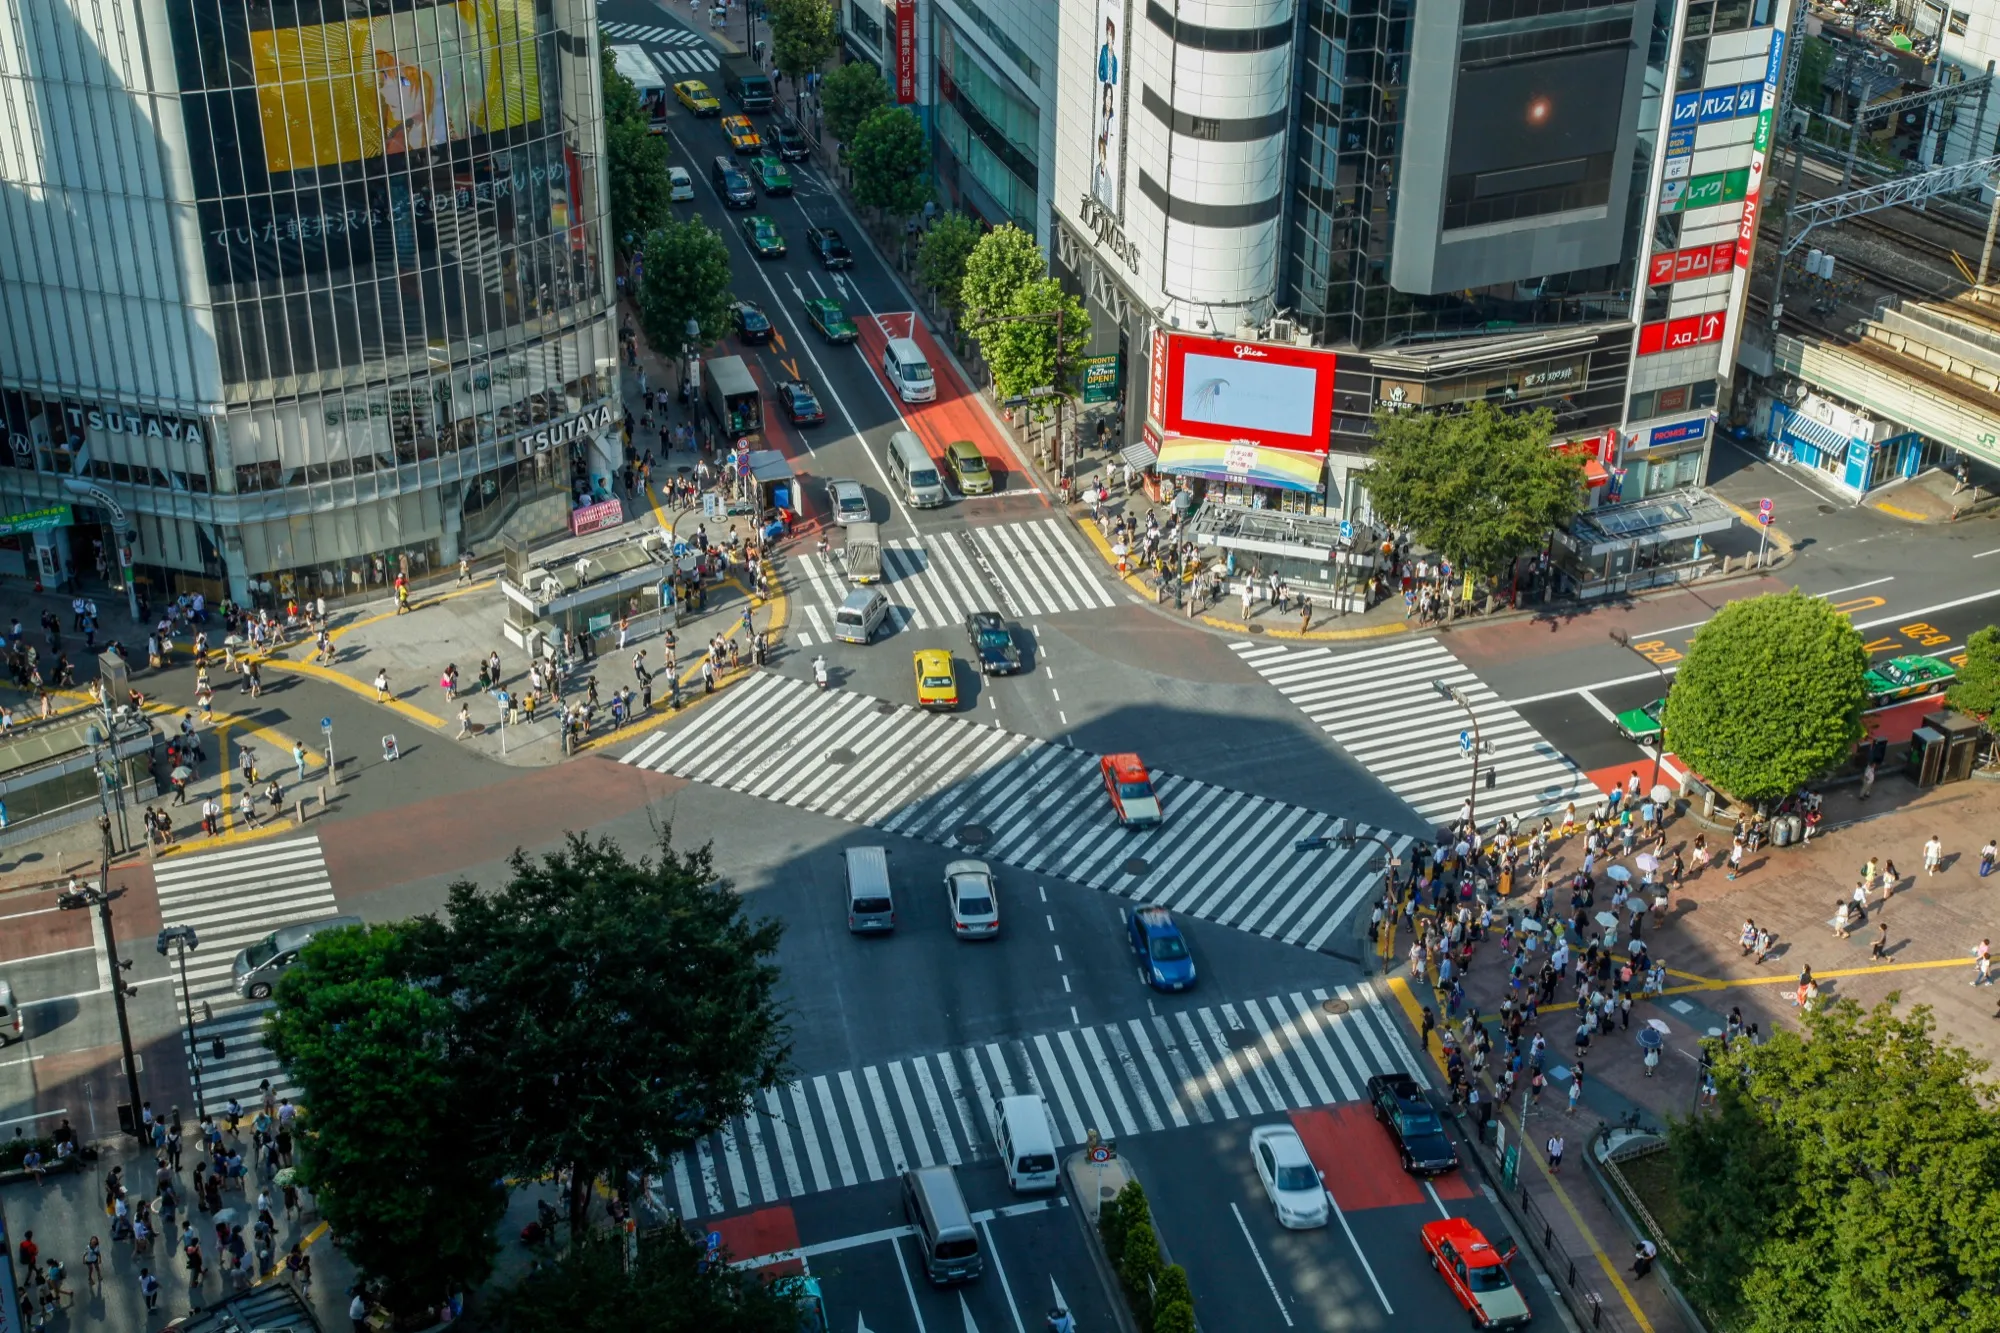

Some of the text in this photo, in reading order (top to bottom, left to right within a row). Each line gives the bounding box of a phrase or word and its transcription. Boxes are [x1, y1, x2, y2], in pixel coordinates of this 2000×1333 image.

[1758, 115, 1769, 143] レイク
[1671, 167, 1681, 176] 6F
[1687, 181, 1722, 200] レイク
[1742, 201, 1755, 240] アコム
[1655, 254, 1708, 277] アコム
[1672, 332, 1692, 345] 入口
[1087, 356, 1116, 365] PRONTO
[1233, 345, 1268, 358] Glico
[68, 407, 201, 445] TSUTAYA
[521, 405, 612, 456] TSUTAYA
[1654, 427, 1687, 440] PROMISE
[1976, 431, 1996, 447] JR
[1634, 639, 1684, 664] 8-20
